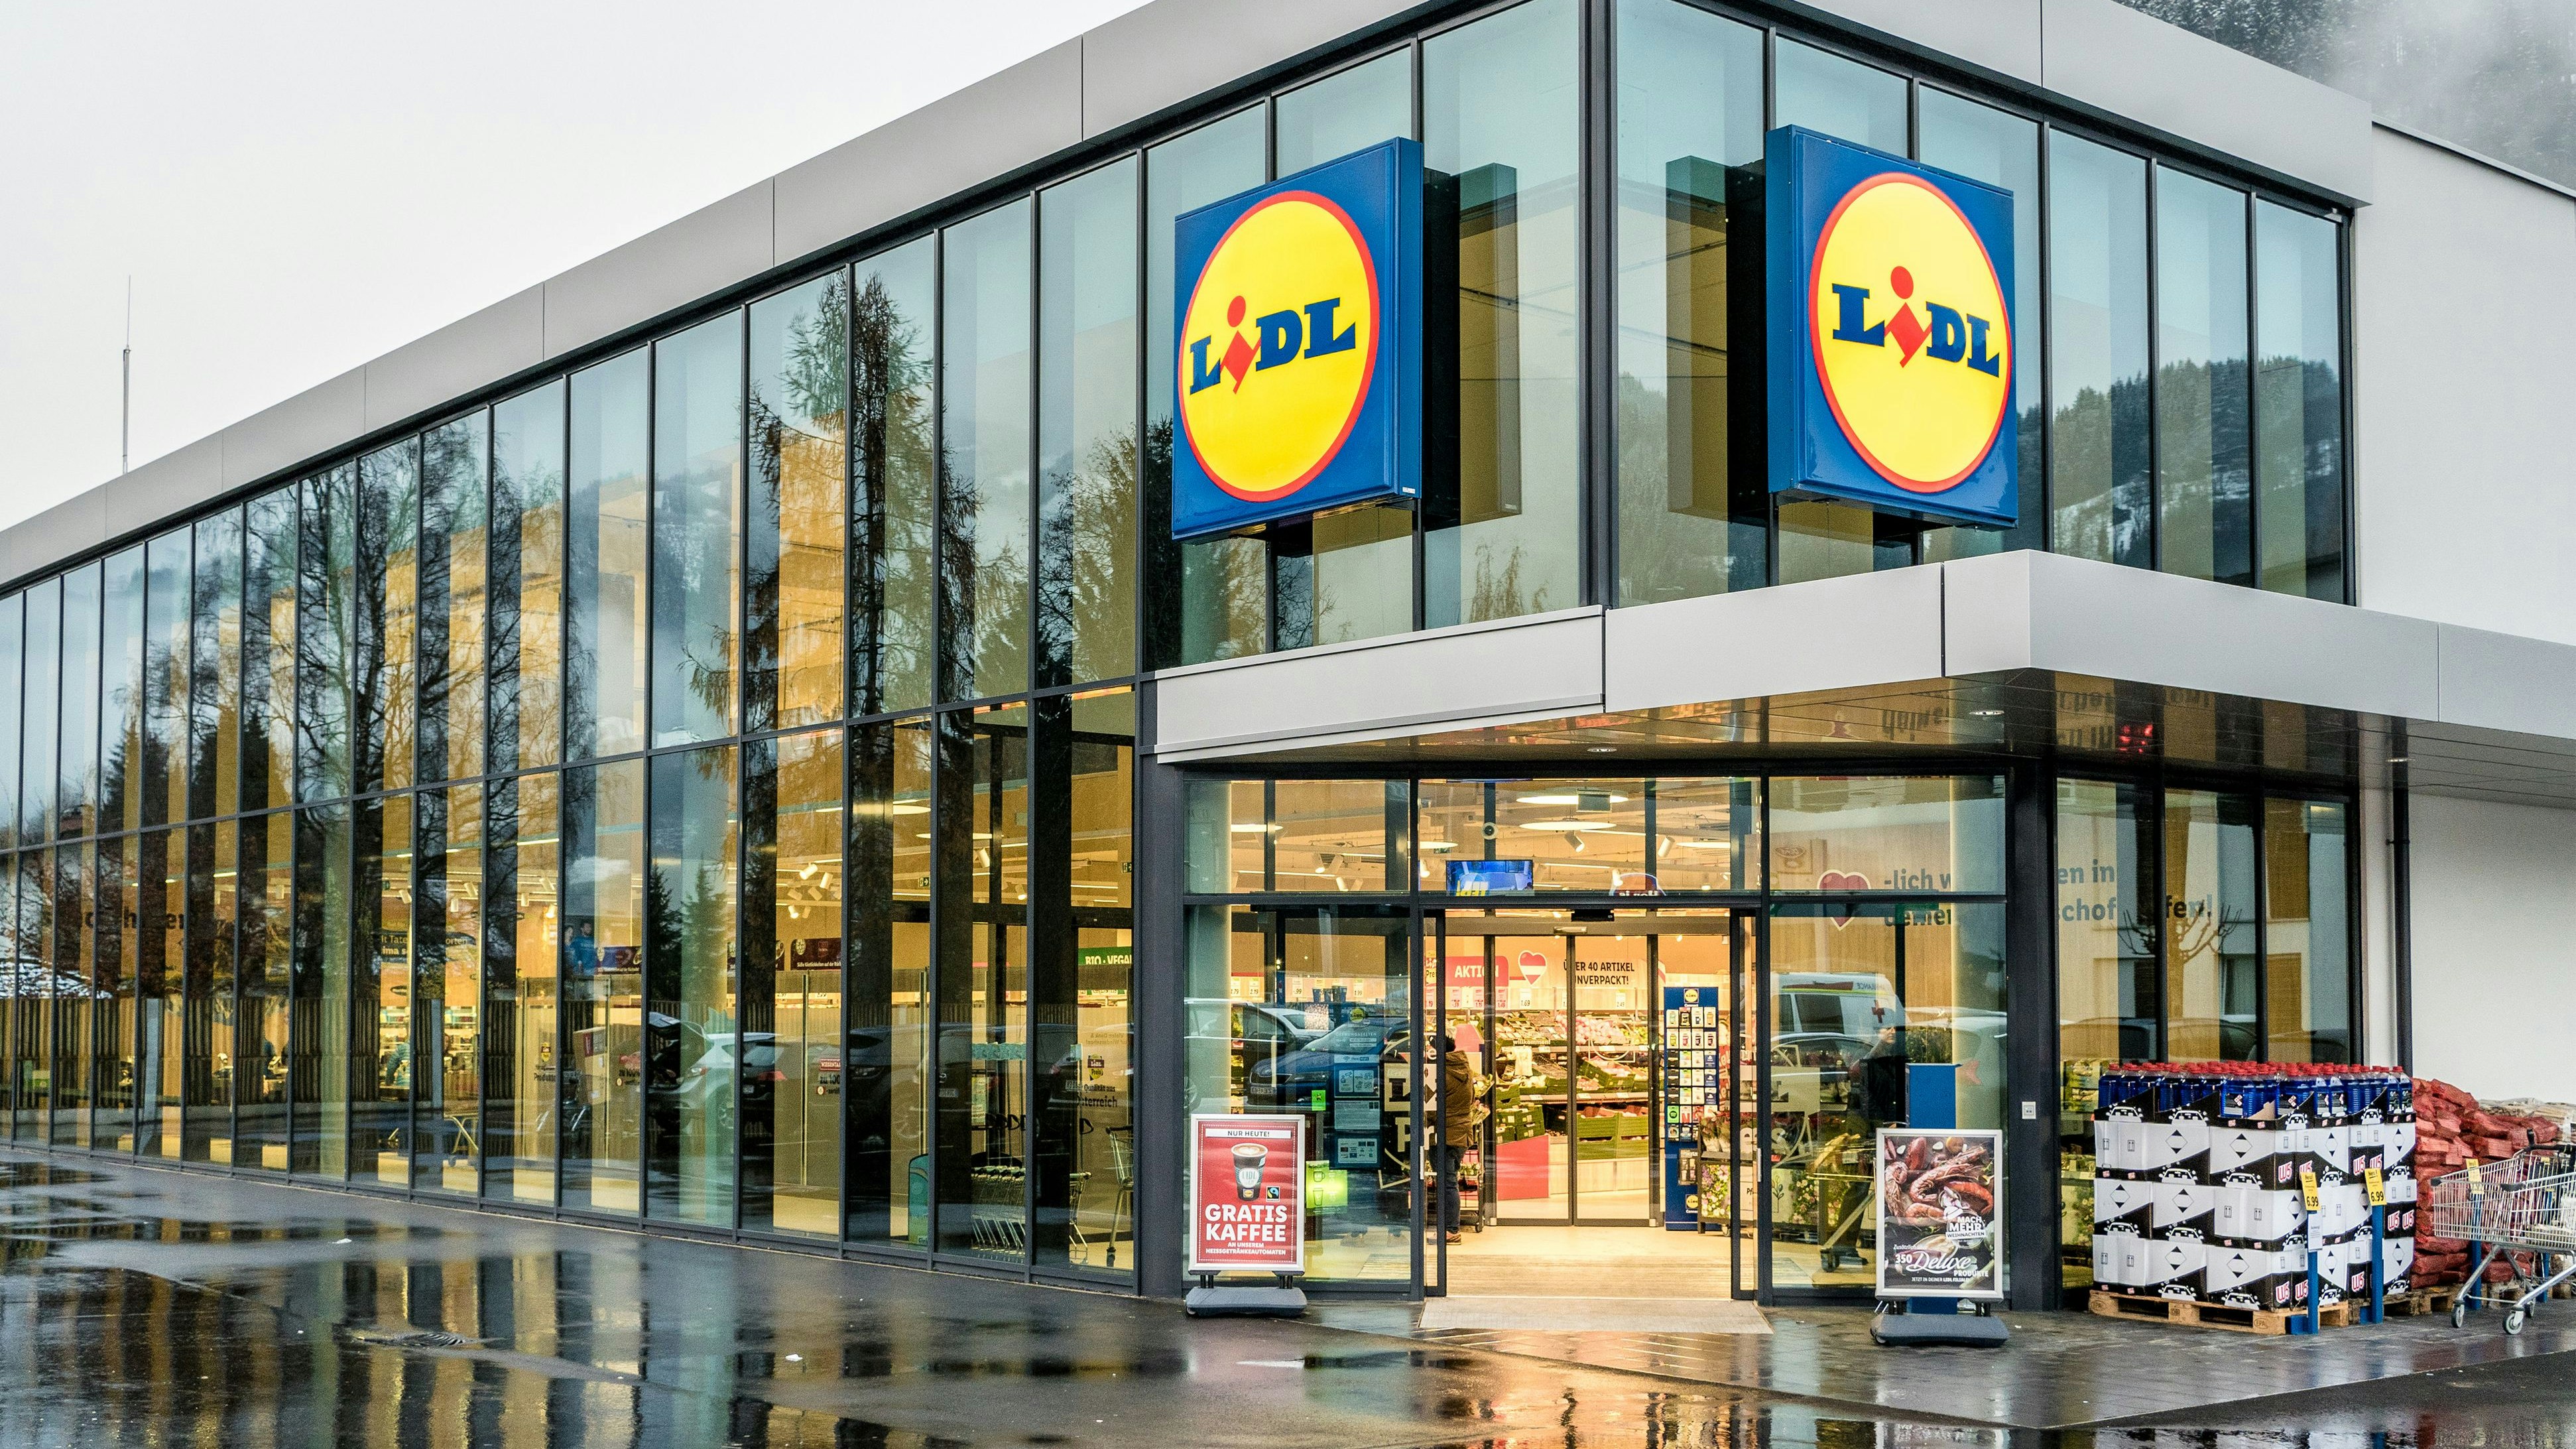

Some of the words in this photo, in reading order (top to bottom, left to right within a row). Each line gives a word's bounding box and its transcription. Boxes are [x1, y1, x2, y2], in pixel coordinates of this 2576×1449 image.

[1454, 965, 1499, 978] AKTIN
[1588, 962, 1598, 971] 40
[1600, 962, 1634, 972] ARTIKEL
[1575, 975, 1629, 985] NVERPACKT!
[1077, 1095, 1118, 1108] terreich
[2306, 1196, 2319, 1207] 6.99
[2370, 1191, 2384, 1202] 6.99
[1205, 1204, 1288, 1223] GRATIS
[1206, 1223, 1286, 1242] KAFFEE
[1949, 1222, 1983, 1232] MEHR
[1895, 1253, 1913, 1264] 350
[1906, 1251, 1971, 1274] Deluxe
